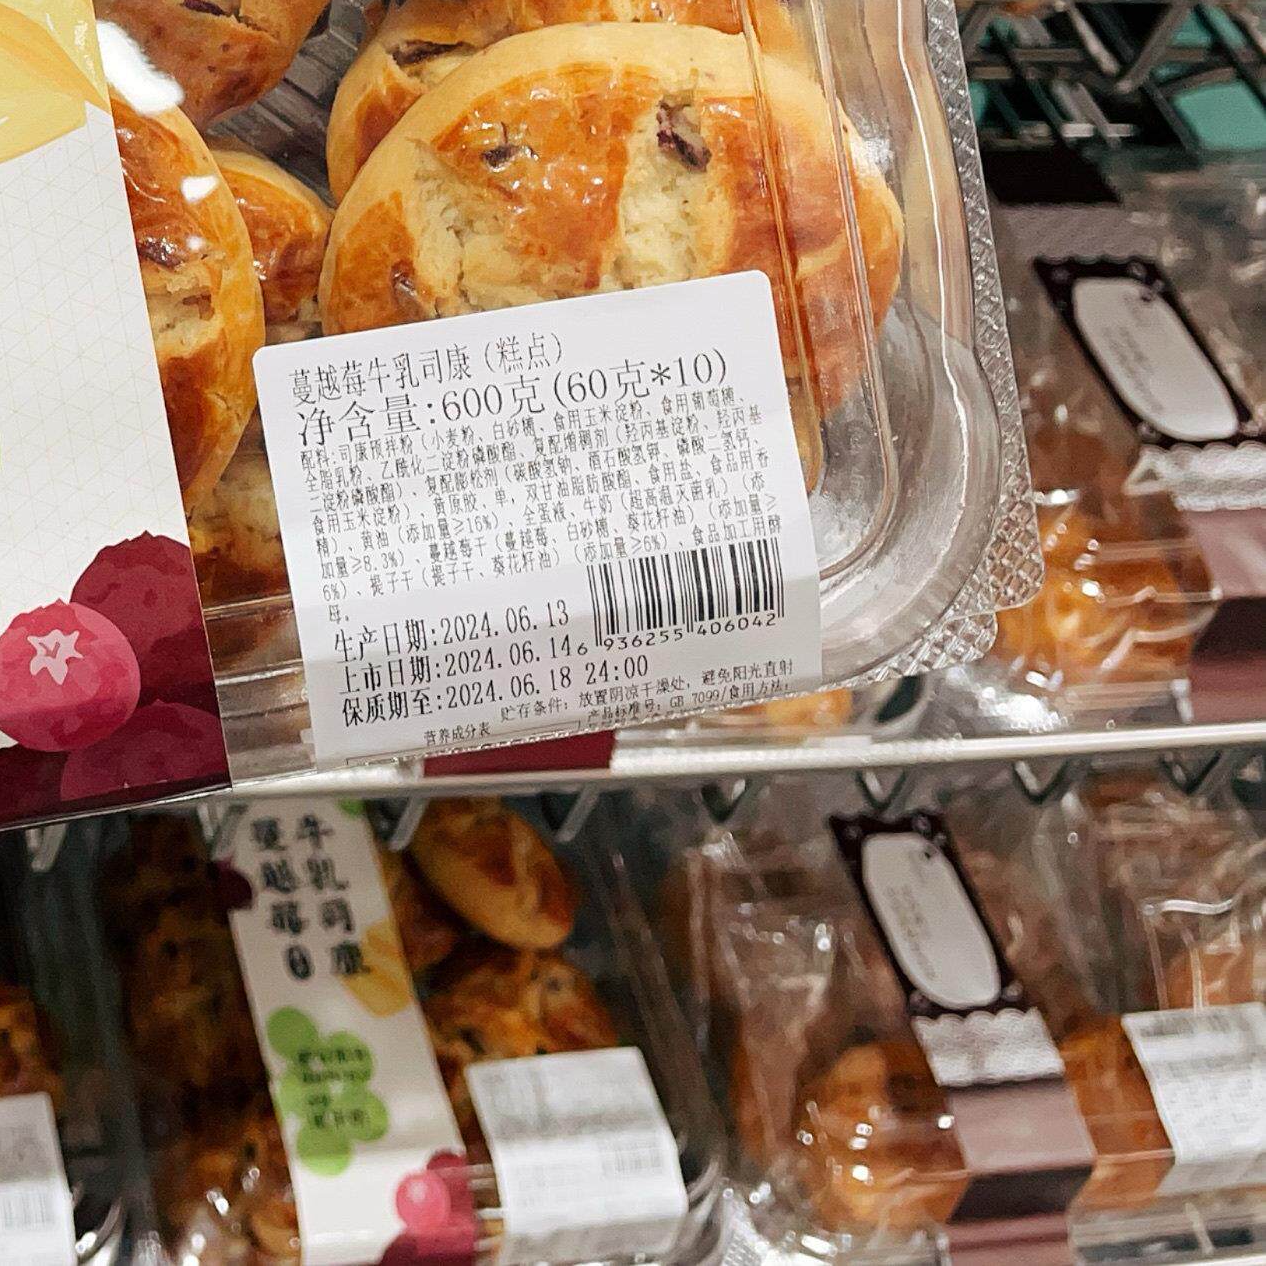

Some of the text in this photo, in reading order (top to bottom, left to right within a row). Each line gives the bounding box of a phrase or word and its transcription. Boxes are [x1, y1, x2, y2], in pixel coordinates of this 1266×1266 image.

[576, 612, 776, 656] 6 936255 406042
[583, 653, 650, 685] 24:00
